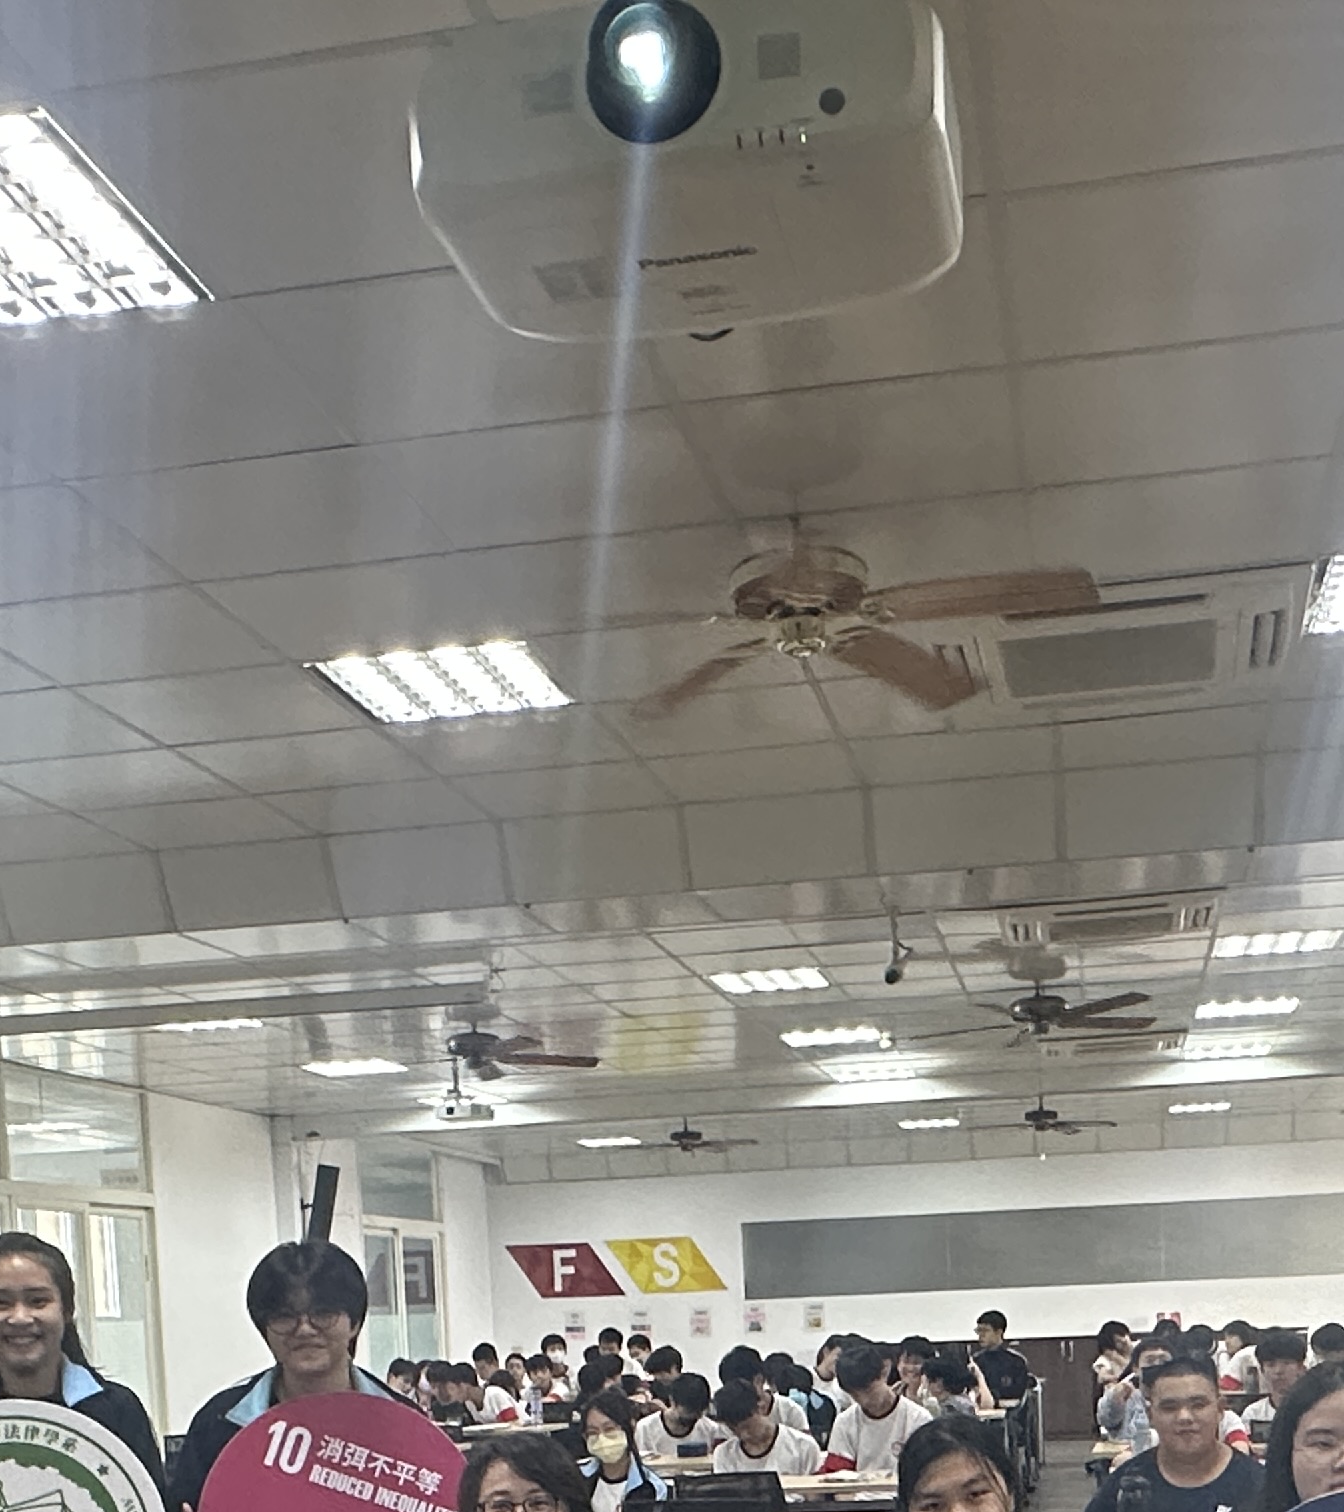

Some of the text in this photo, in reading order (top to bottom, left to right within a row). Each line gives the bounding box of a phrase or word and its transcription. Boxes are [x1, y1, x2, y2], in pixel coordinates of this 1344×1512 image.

[638, 246, 757, 269] Panasonic
[552, 1249, 576, 1292] F
[653, 1243, 680, 1287] S
[263, 1420, 312, 1475] 10
[316, 1434, 443, 1496] 消弭不平等
[309, 1464, 374, 1501] REDUCED
